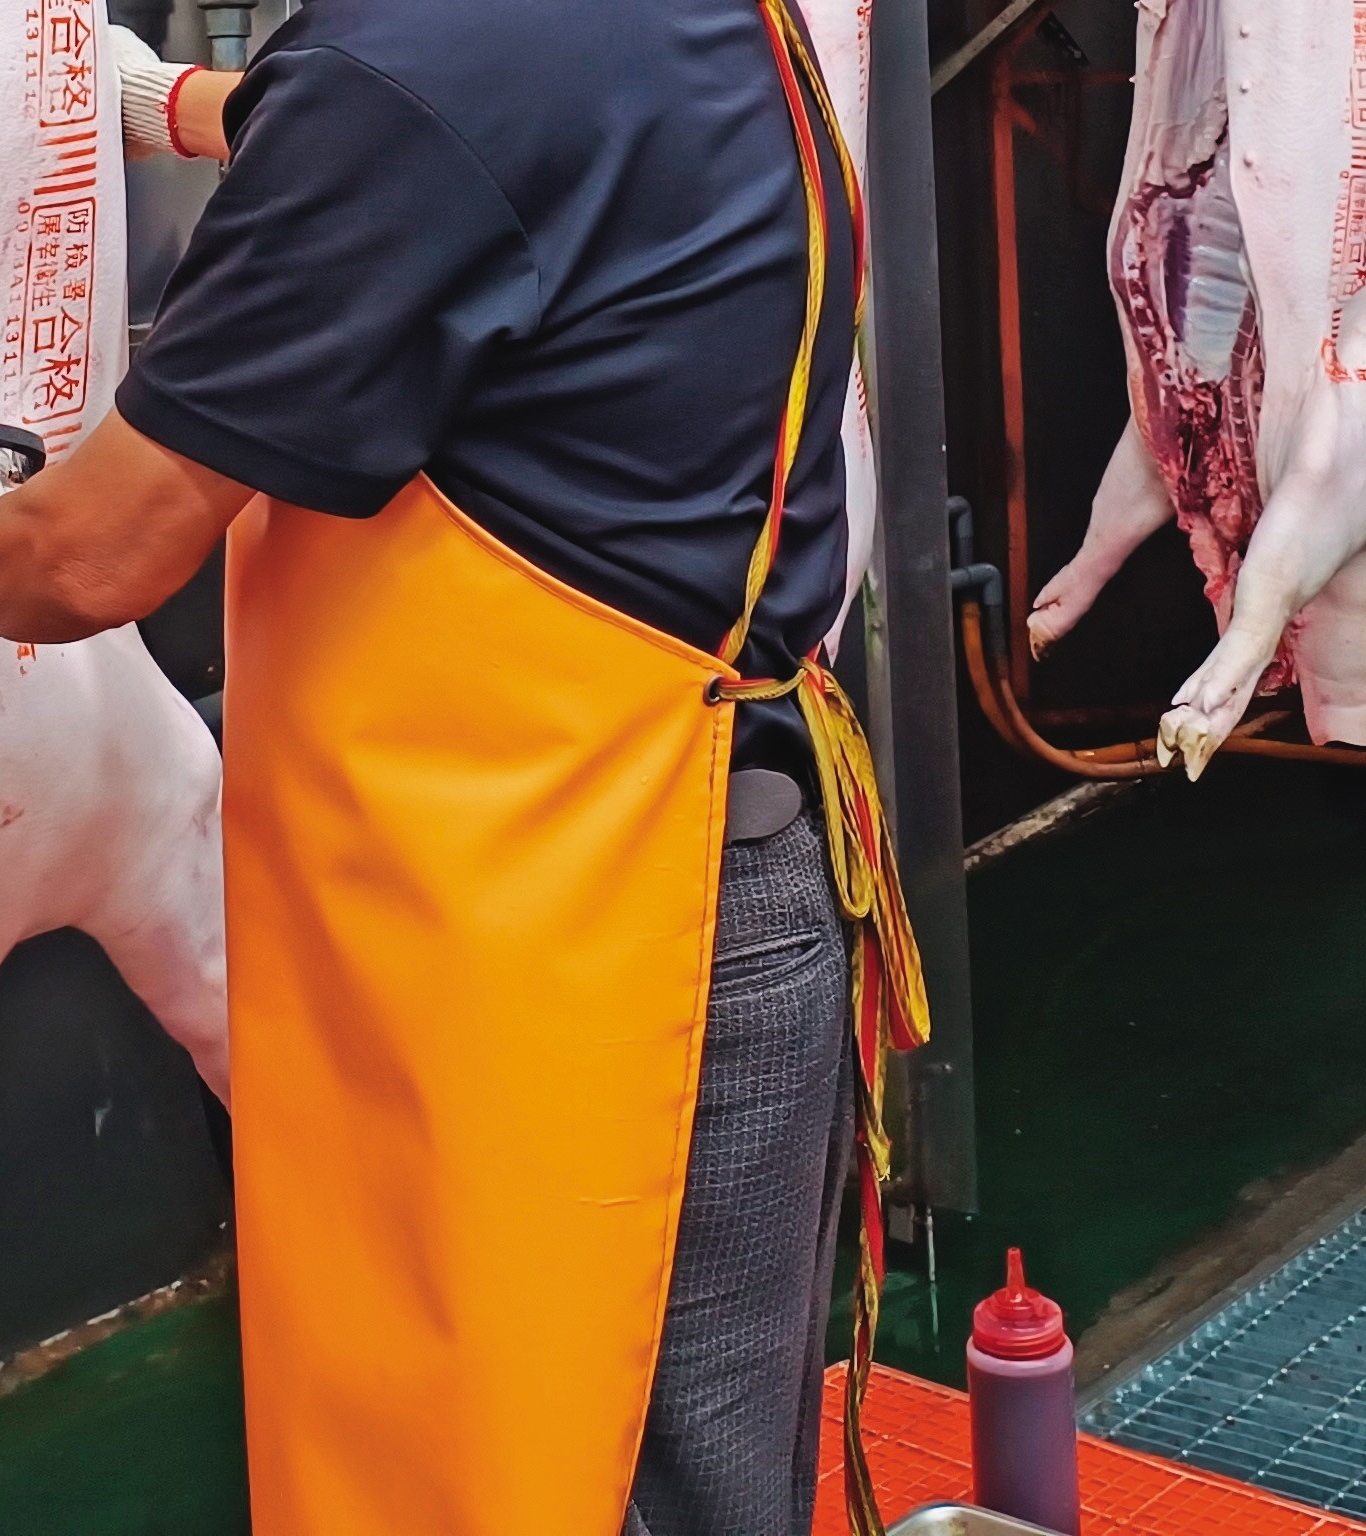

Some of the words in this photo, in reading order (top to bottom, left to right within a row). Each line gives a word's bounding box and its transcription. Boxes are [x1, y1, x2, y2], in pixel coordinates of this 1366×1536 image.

[49, 9, 92, 116] 合格
[62, 208, 89, 301] 防檢署
[30, 307, 84, 409] 合格
